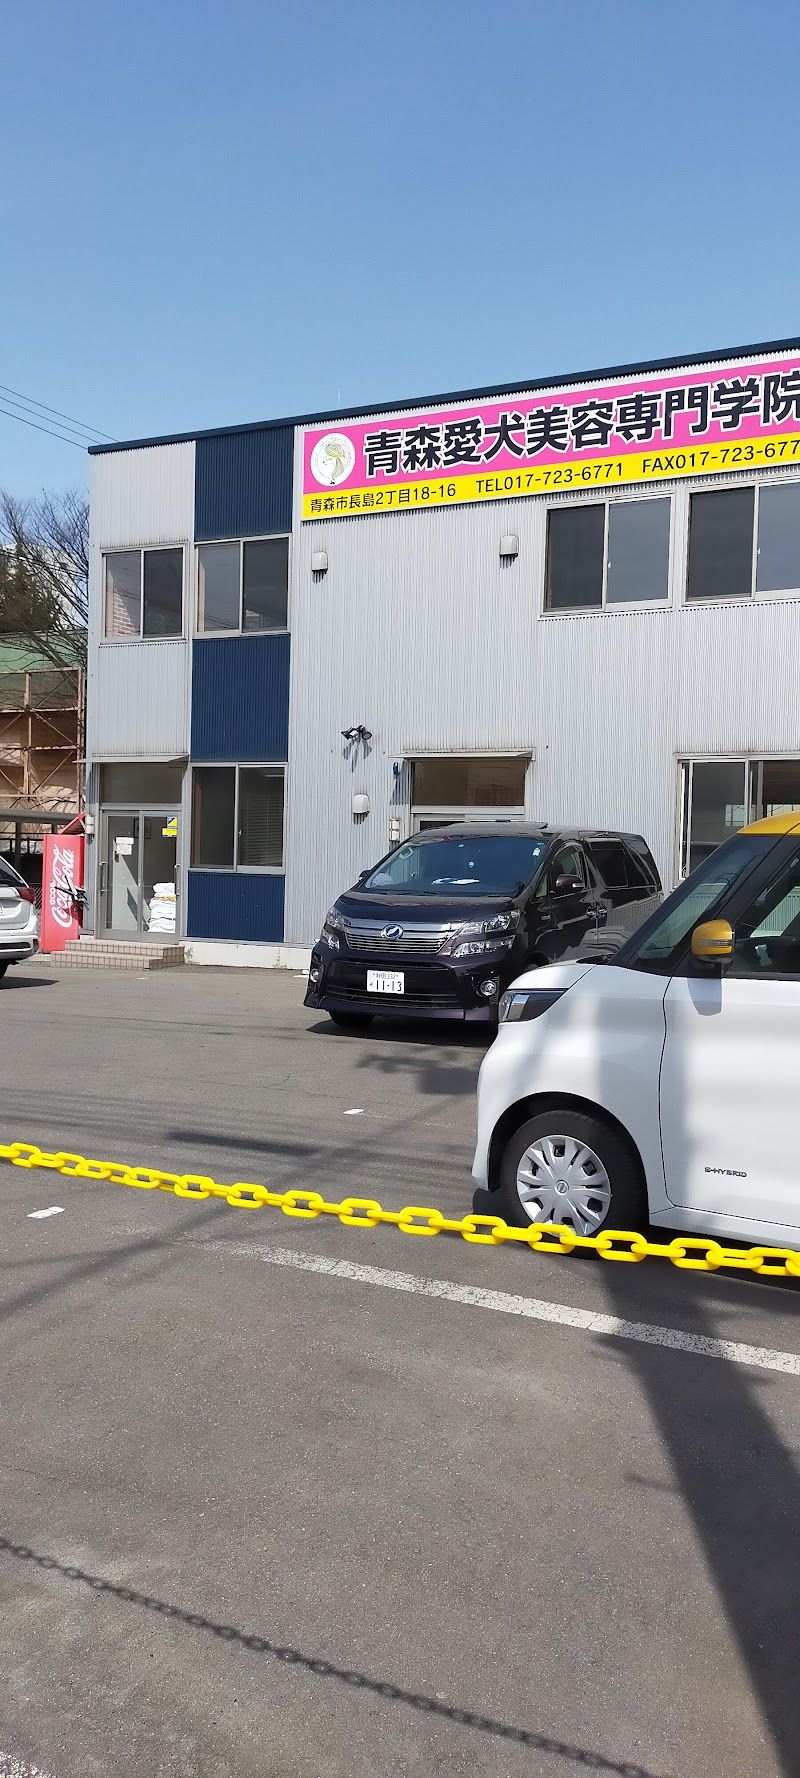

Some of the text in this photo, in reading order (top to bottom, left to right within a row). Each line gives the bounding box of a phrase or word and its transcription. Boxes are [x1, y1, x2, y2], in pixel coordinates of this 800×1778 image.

[364, 371, 800, 476] 青森愛犬美容専門学院
[310, 484, 456, 513] 青森市長島2丁目18-16
[476, 463, 623, 493] TEL017-723-6771
